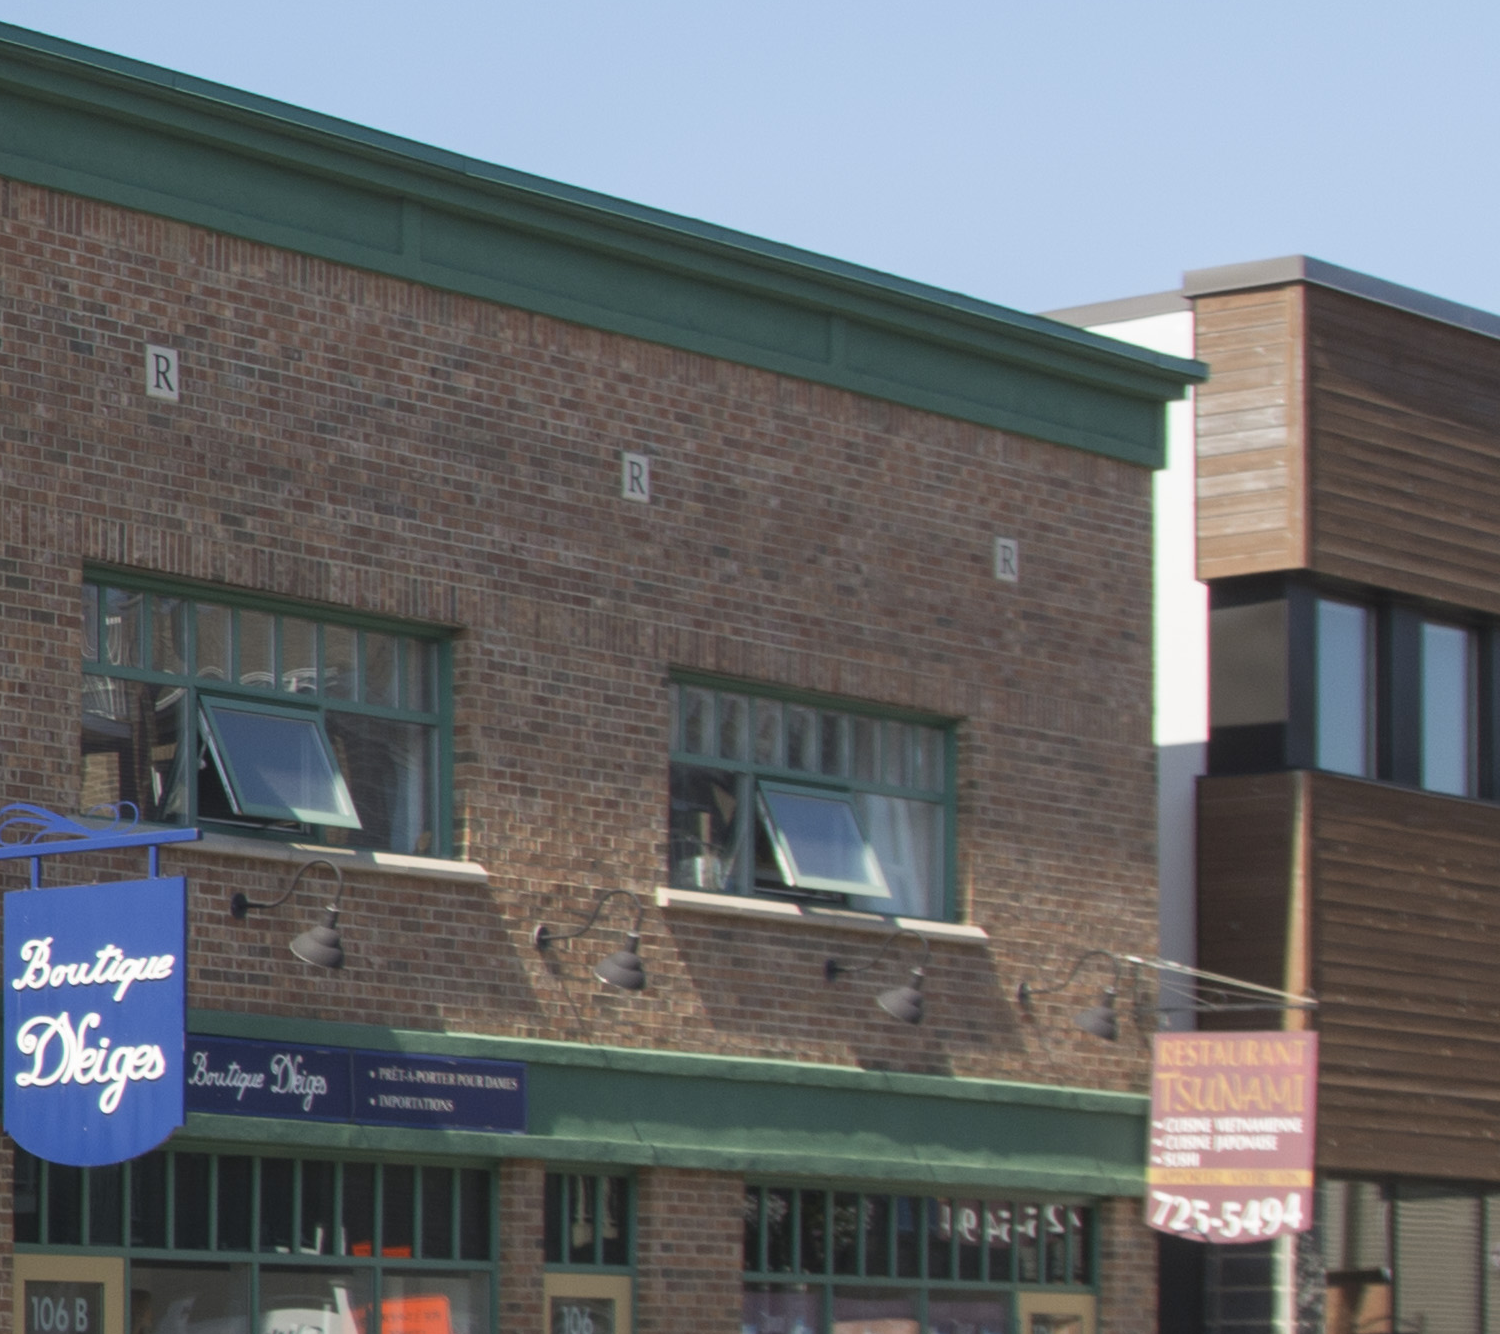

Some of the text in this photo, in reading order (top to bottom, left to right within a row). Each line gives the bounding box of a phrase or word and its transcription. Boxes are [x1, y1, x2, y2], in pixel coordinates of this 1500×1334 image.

[151, 353, 175, 393] R
[627, 460, 646, 495] R
[1000, 544, 1017, 576] R
[11, 936, 176, 1003] Boutique
[1158, 1039, 1309, 1067] RESTAURANT
[187, 1050, 266, 1102] Boutique
[457, 1071, 484, 1089] POUR
[485, 1074, 519, 1091] DAMES
[1154, 1070, 1306, 1113] TSUNAMI
[378, 1093, 455, 1113] IMPORTATIONS
[1163, 1116, 1213, 1134] CUISINE
[1162, 1134, 1213, 1151] CUISINE
[1161, 1151, 1201, 1168] SUSHI
[1151, 1190, 1304, 1238] 725-5494
[31, 1296, 89, 1333] 106 B
